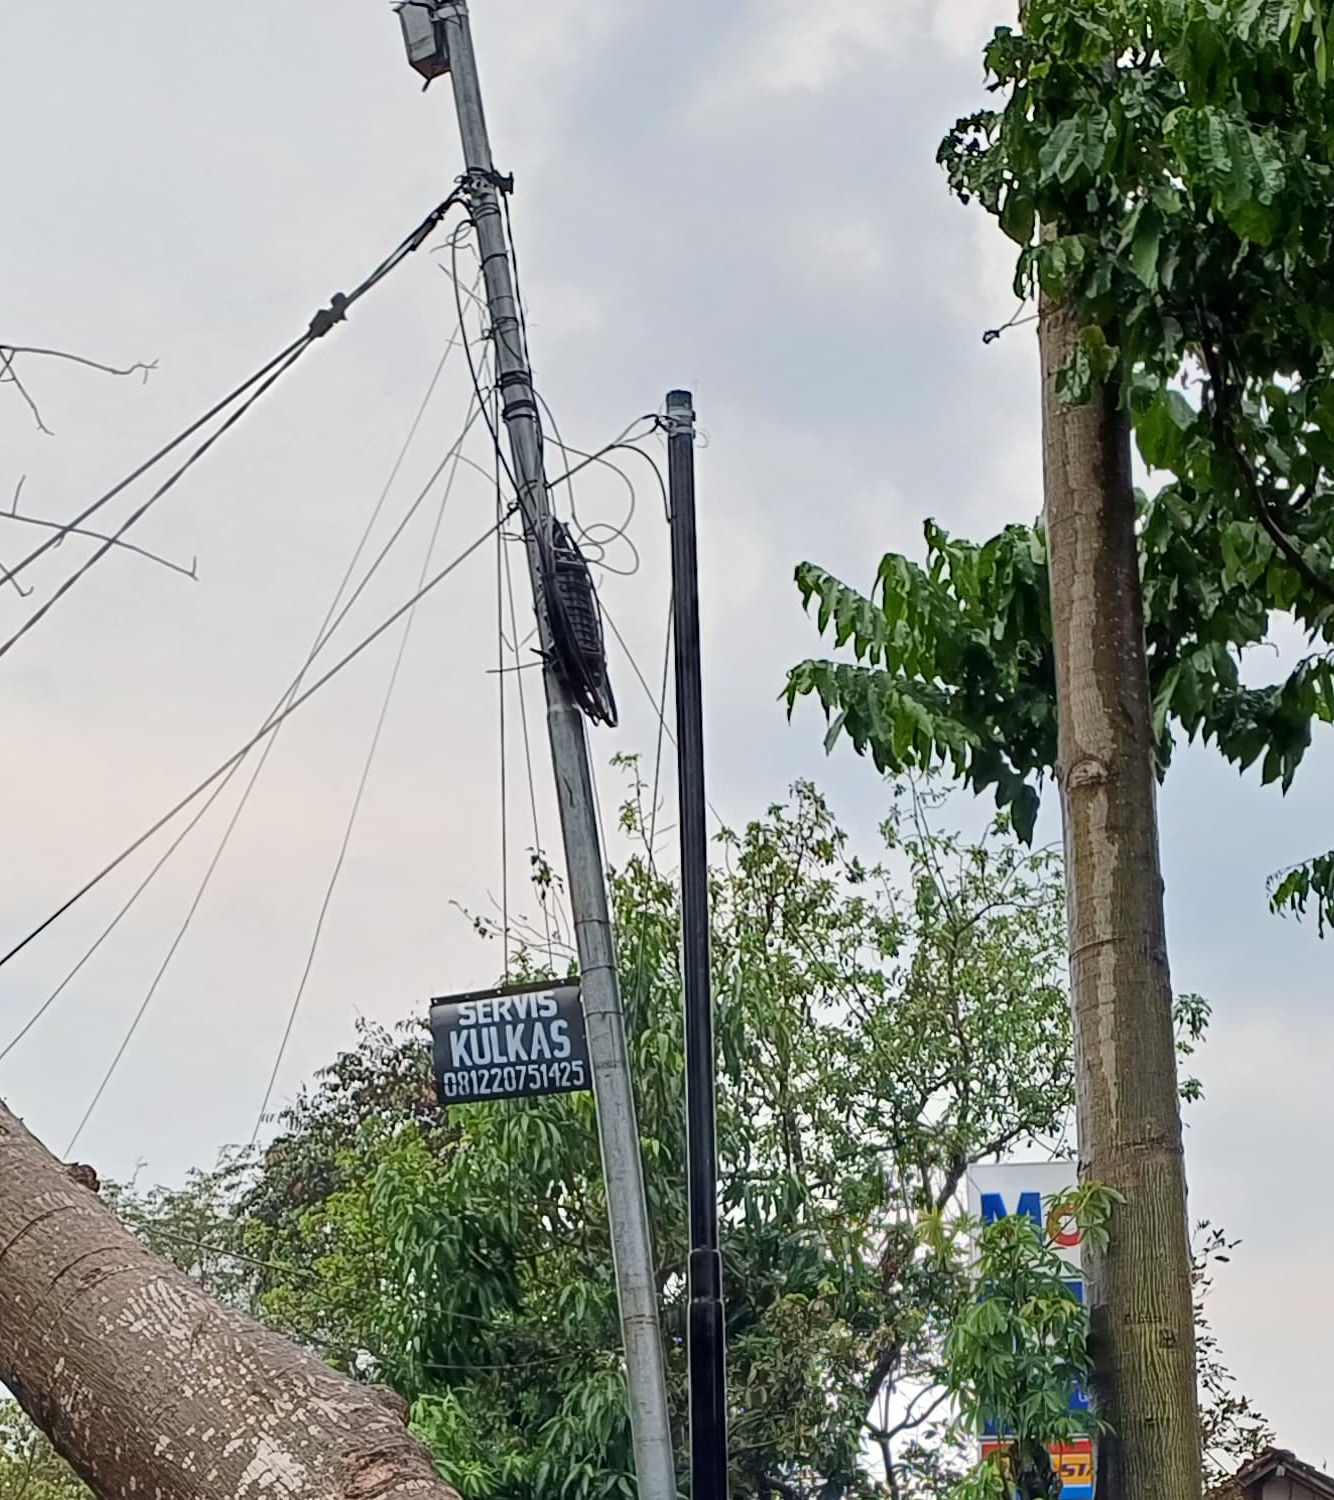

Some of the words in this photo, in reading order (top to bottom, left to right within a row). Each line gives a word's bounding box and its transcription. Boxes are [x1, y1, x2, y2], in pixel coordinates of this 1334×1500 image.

[456, 990, 558, 1026] SERVIS
[448, 1019, 571, 1068] KULKAS
[442, 1060, 585, 1098] 081220751425
